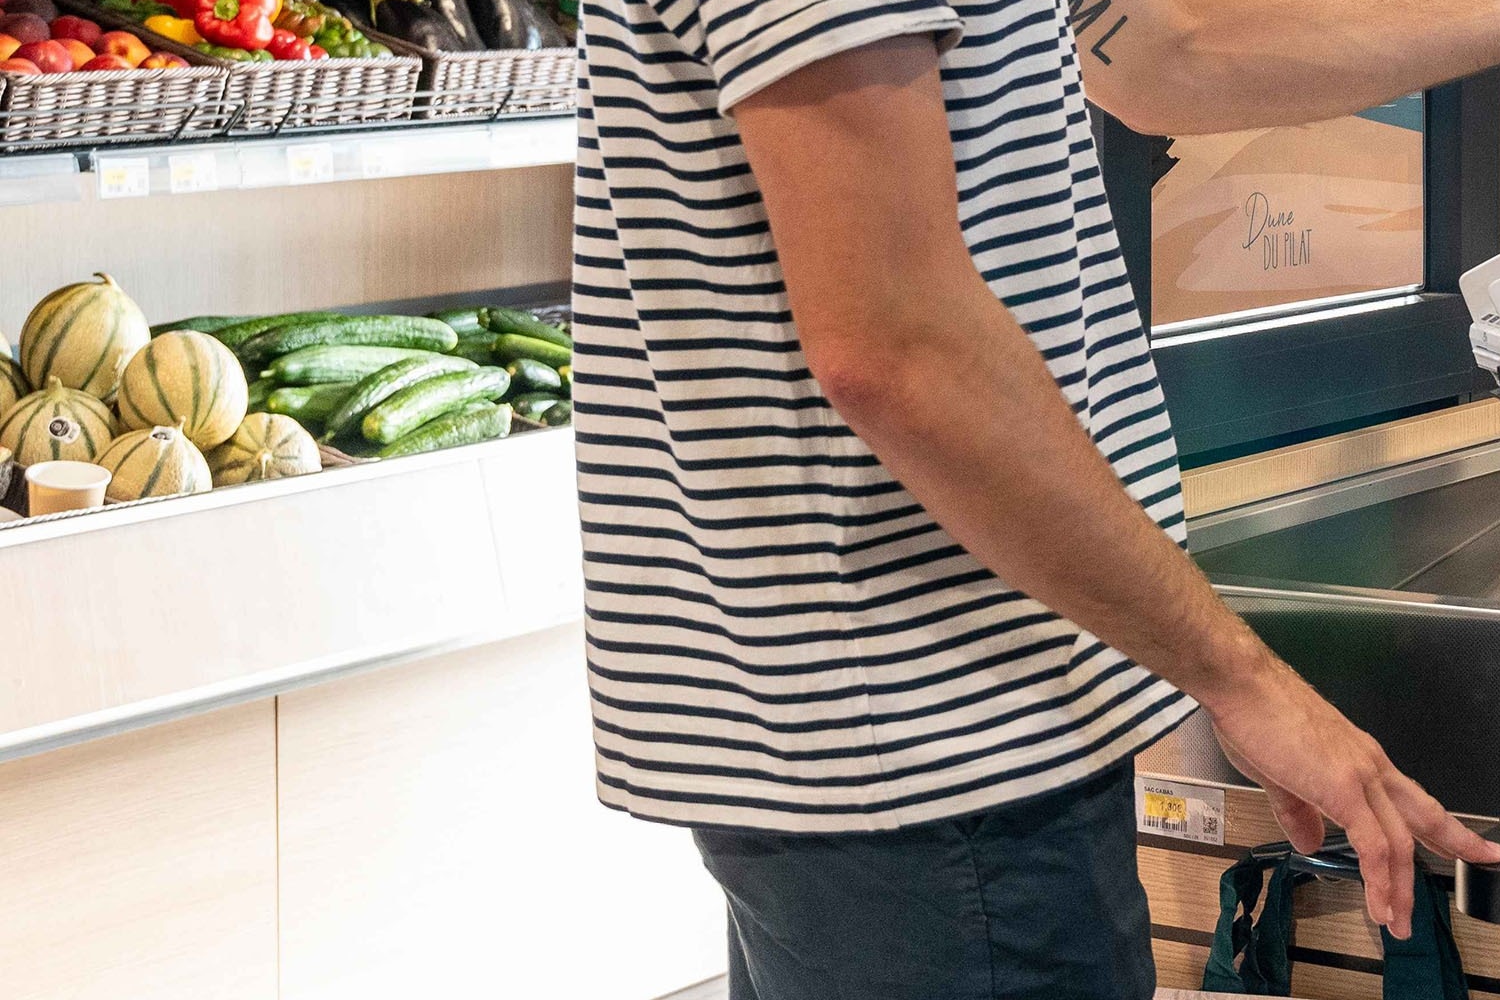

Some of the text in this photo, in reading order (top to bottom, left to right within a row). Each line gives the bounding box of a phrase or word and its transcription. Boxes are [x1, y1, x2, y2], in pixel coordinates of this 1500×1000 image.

[1242, 192, 1294, 250] Dune
[1264, 229, 1312, 270] DU PILAT
[1155, 787, 1173, 795] CABAS
